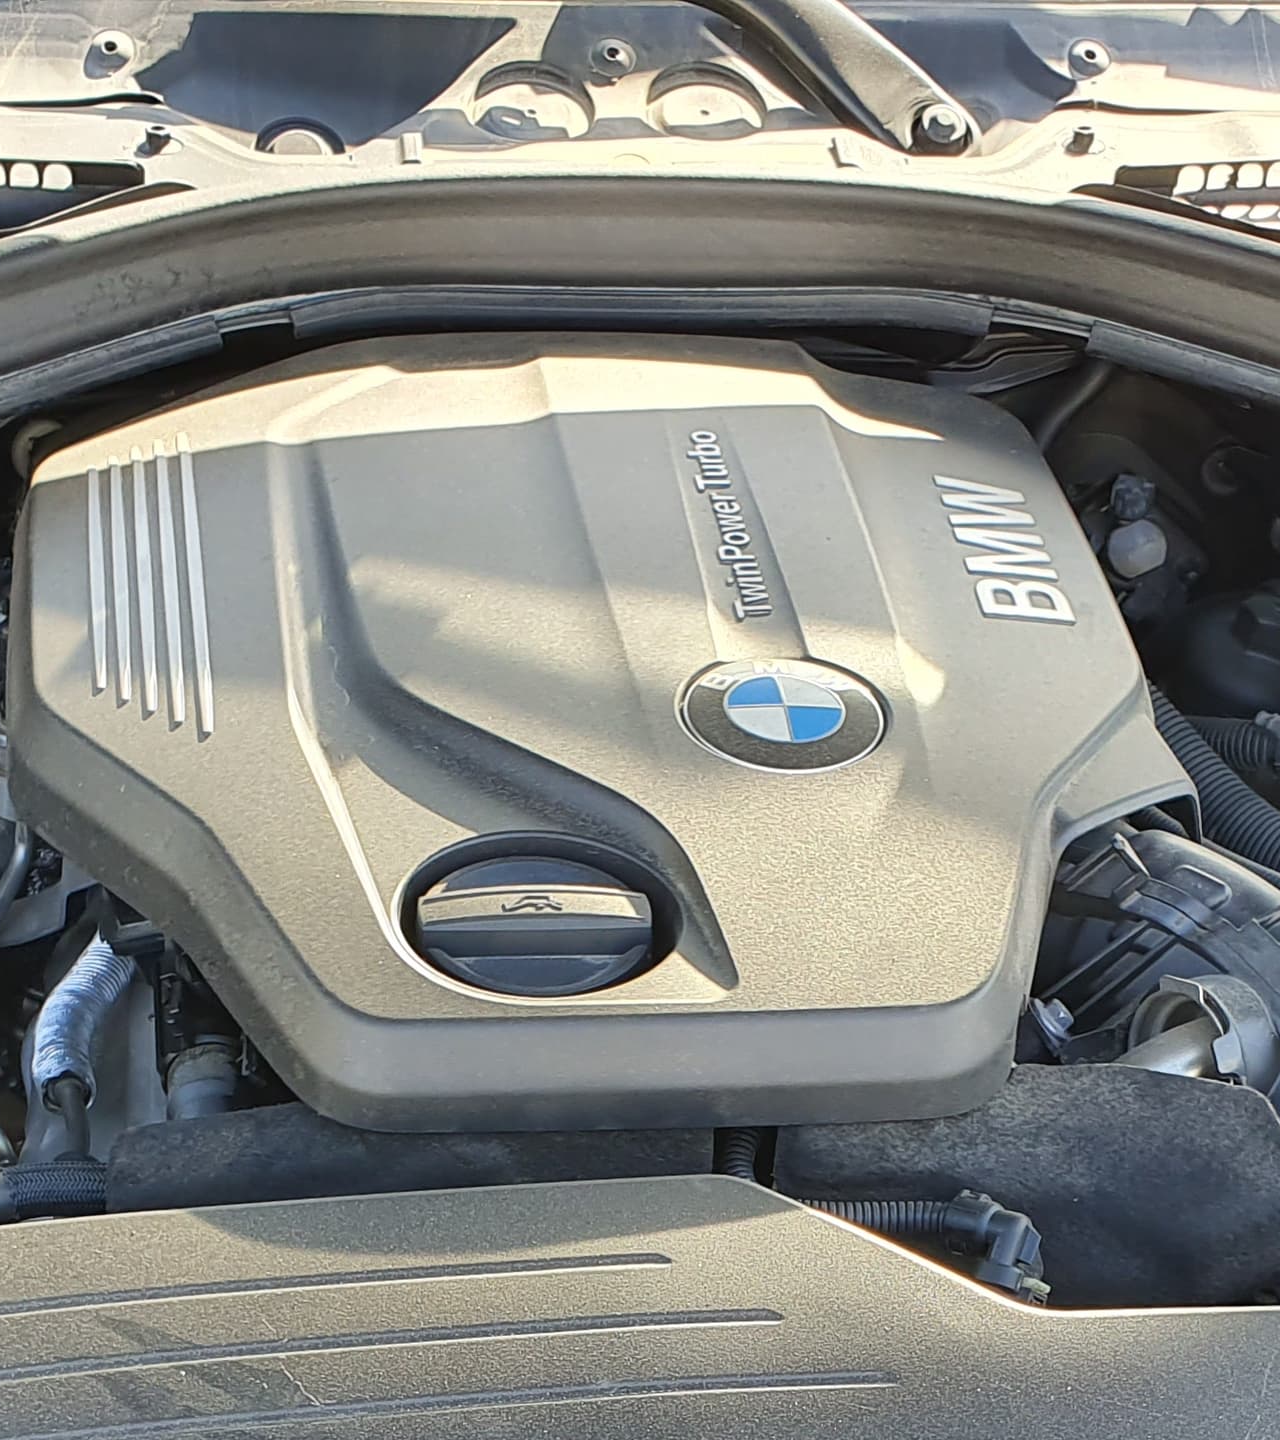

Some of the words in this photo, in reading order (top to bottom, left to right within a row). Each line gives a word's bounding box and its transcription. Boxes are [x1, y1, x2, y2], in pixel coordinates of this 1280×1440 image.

[687, 430, 732, 493] Turbo
[709, 492, 773, 621] TwinPower
[933, 474, 1077, 626] BMW
